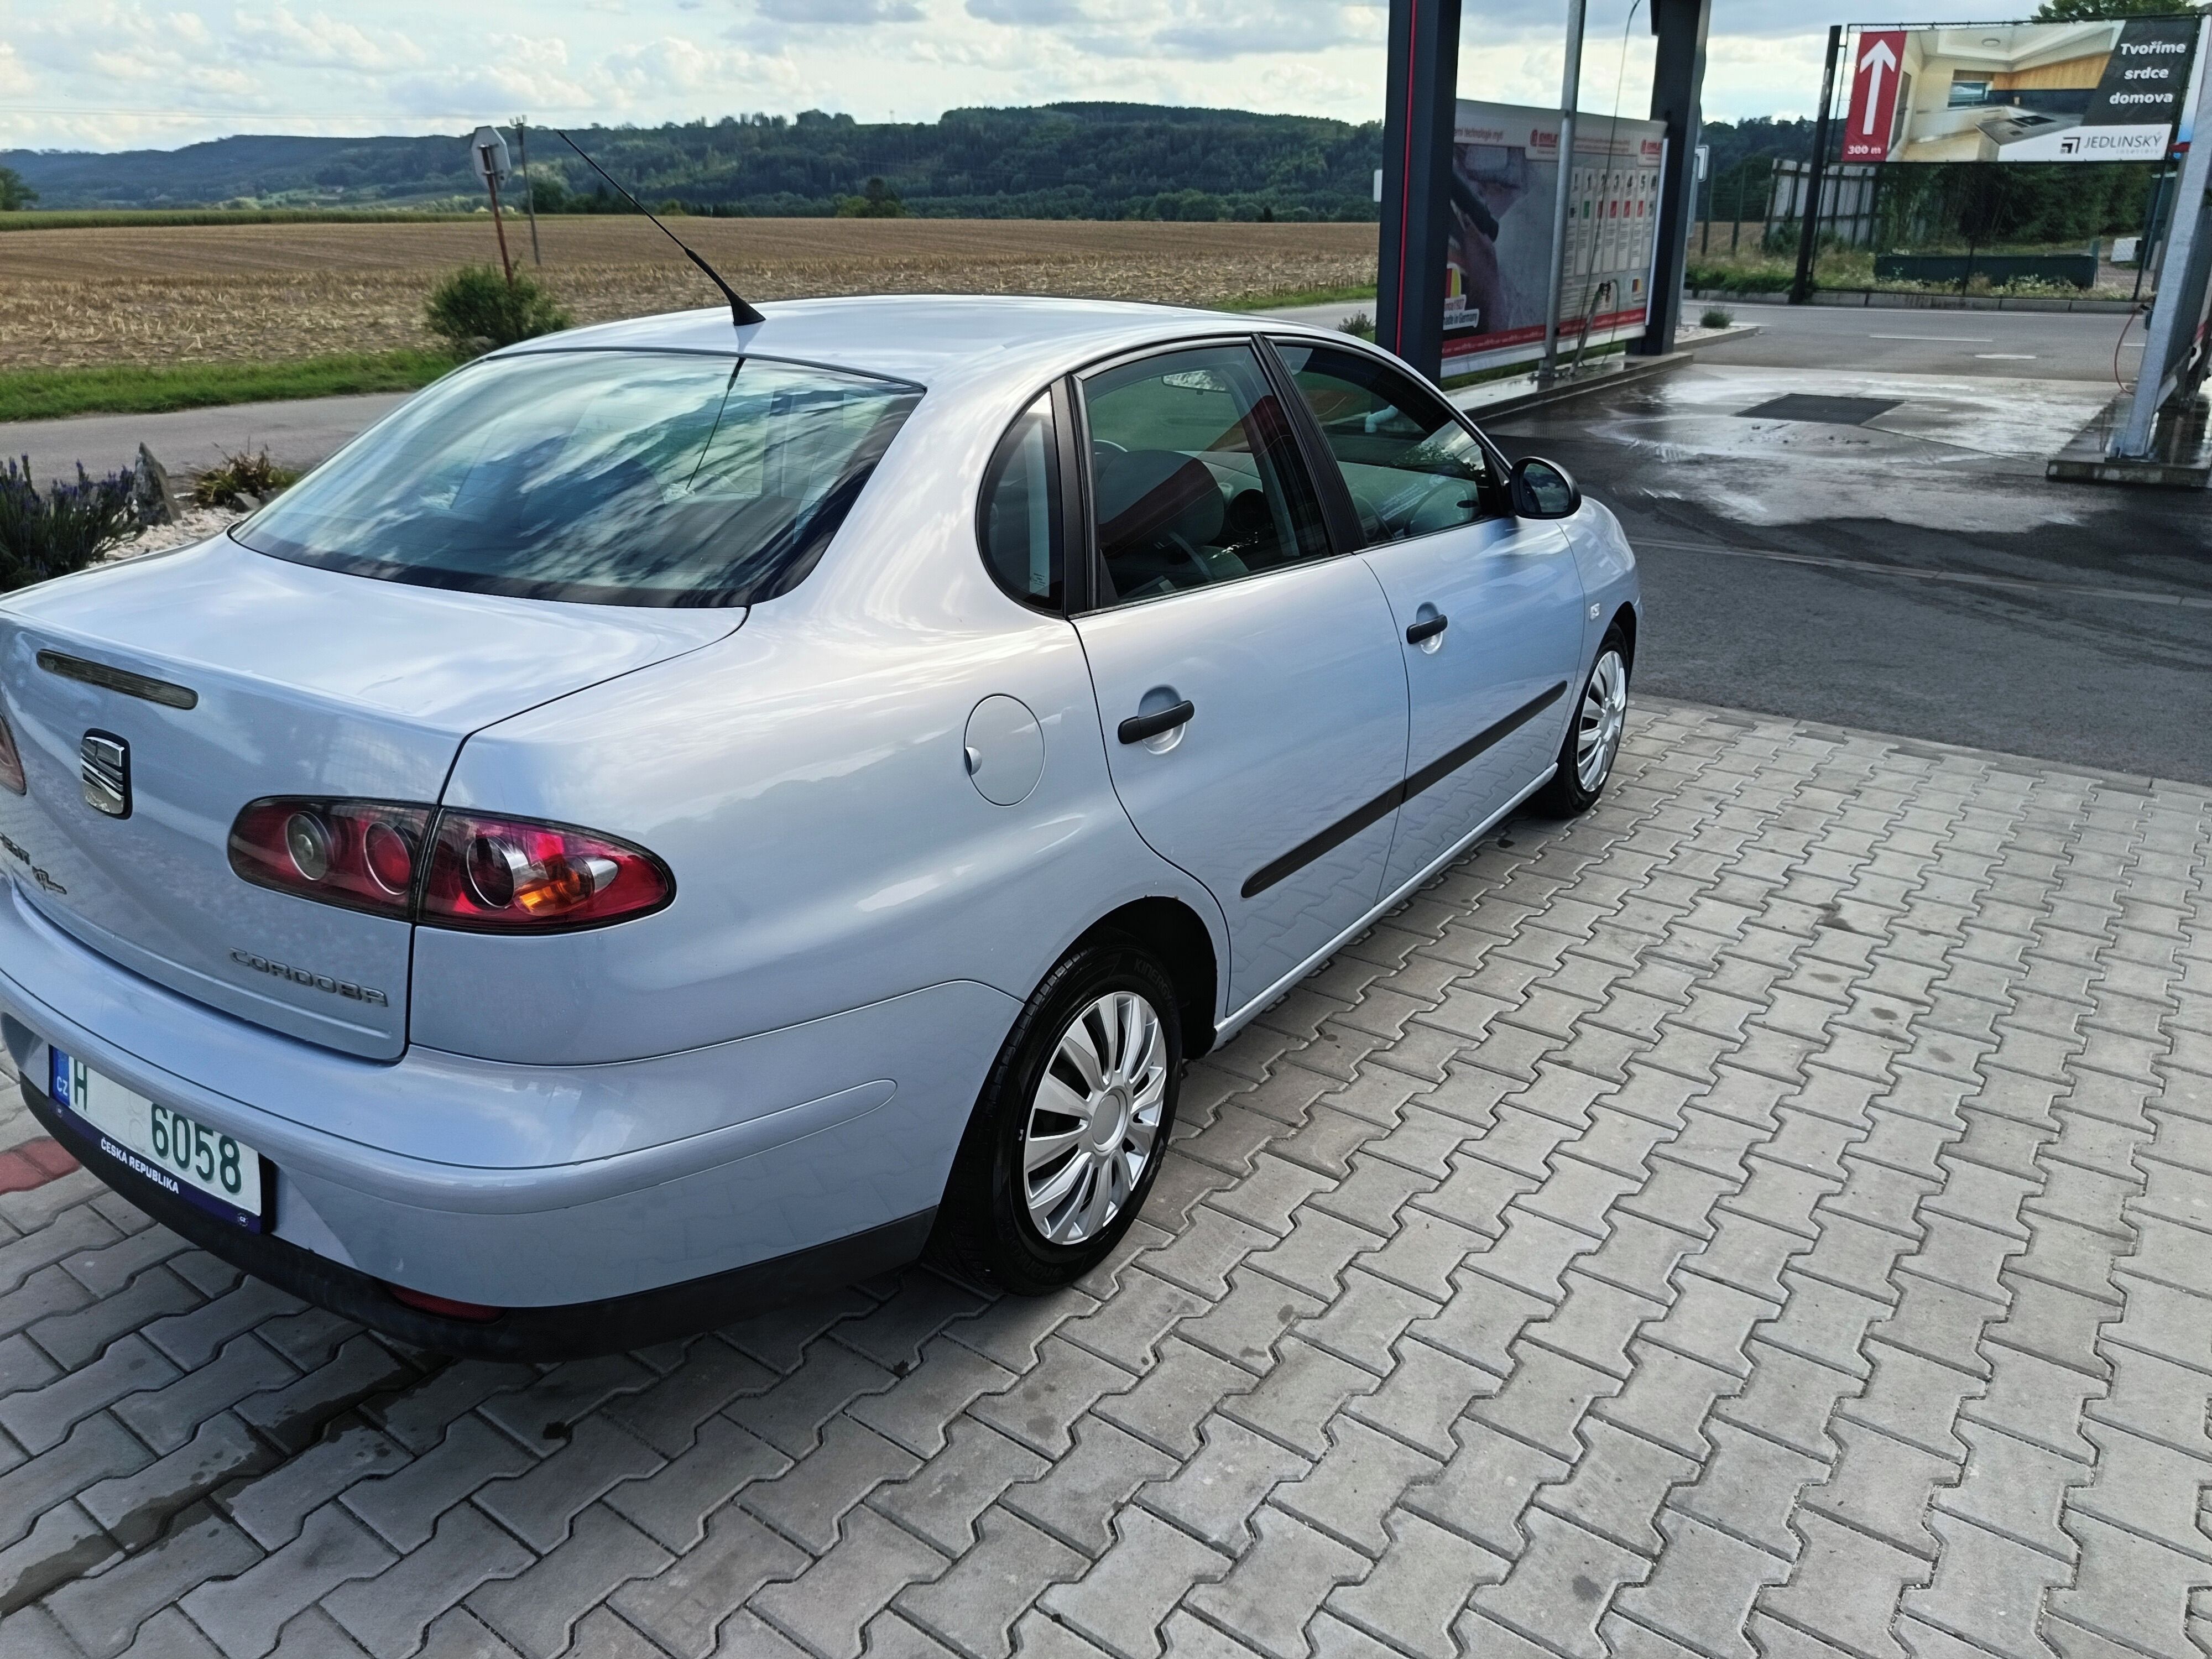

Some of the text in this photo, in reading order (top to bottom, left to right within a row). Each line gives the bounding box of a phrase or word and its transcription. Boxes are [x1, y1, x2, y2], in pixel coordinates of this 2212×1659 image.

[2120, 41, 2186, 55] Tvoříme
[2124, 66, 2169, 80] srdce
[2109, 92, 2173, 104] domova
[2084, 132, 2163, 148] JEDLINSKÝ
[1848, 145, 1869, 154] 300
[229, 947, 388, 1007] CORDOBA
[56, 1076, 68, 1097] CZ
[74, 1058, 242, 1193] H 6058
[101, 1136, 180, 1194] ČESKÁ REPUBLIKA
